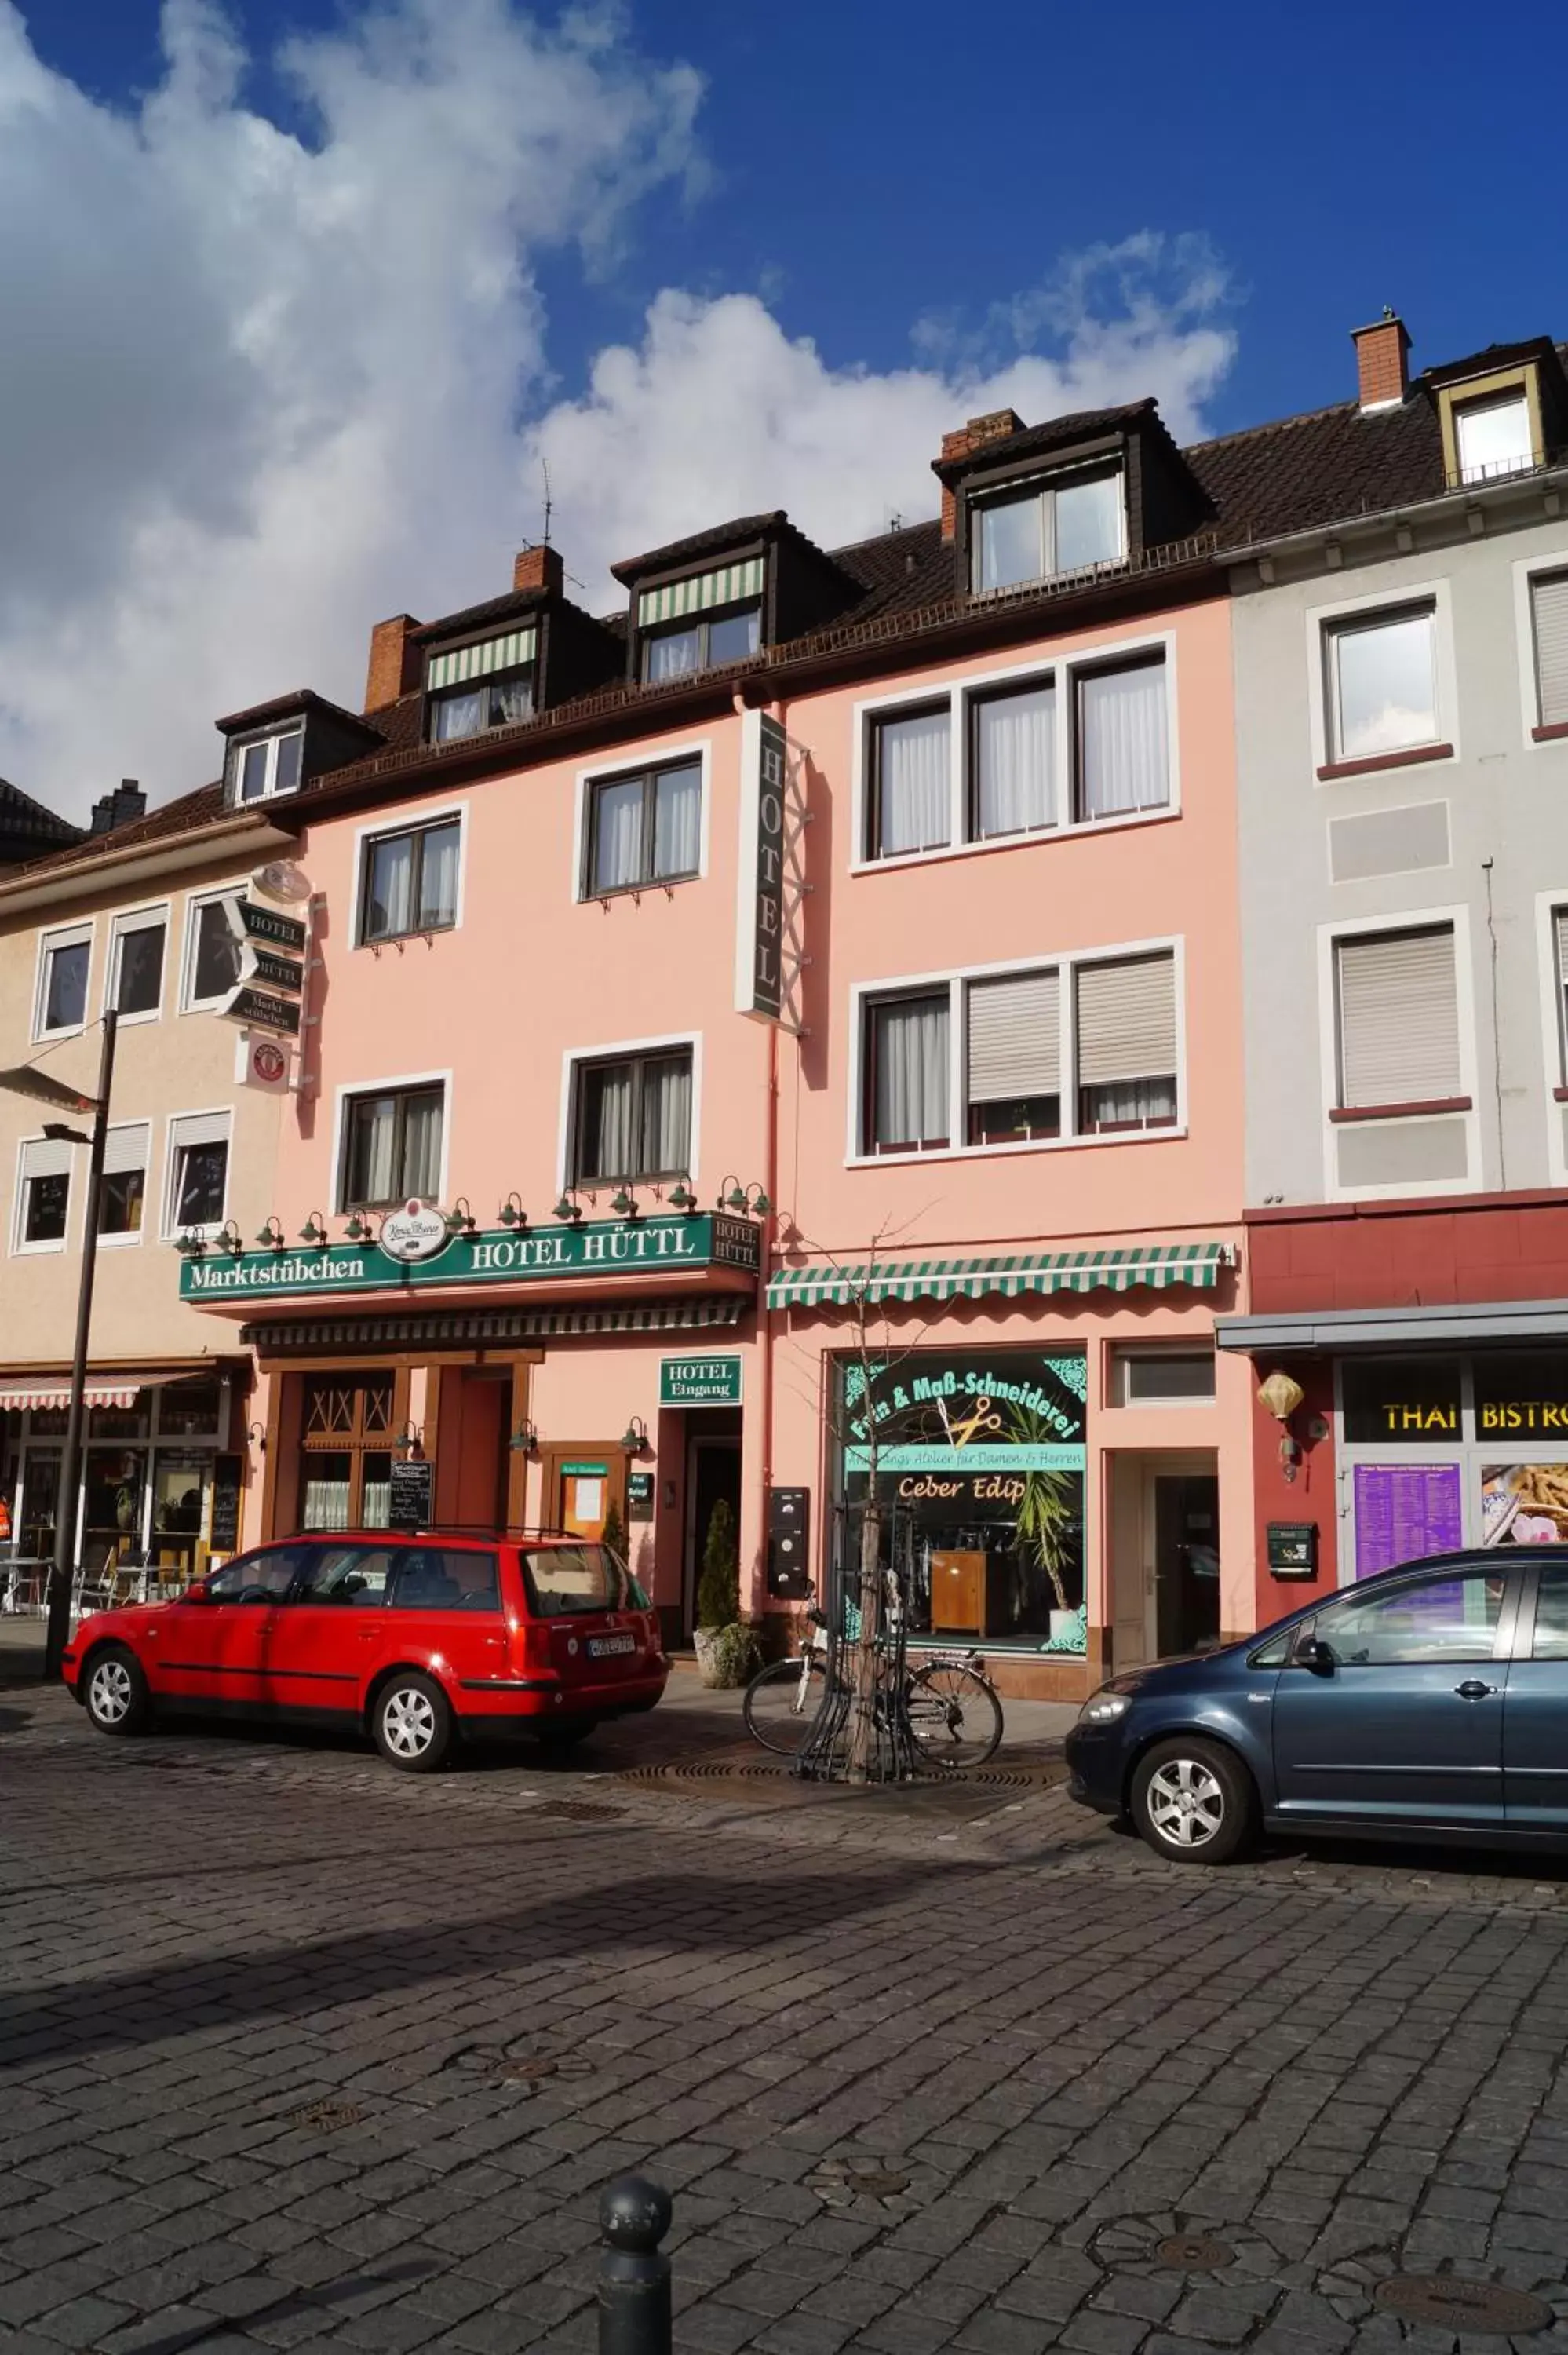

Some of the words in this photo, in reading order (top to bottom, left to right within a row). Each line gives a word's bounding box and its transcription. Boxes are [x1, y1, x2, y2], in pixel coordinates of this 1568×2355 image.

[757, 743, 782, 990] HOTEL
[251, 915, 299, 942] HOTEL
[471, 1238, 572, 1269] HOTEL
[582, 1225, 695, 1261] HÜTTL
[716, 1221, 757, 1245] HOTEL
[190, 1254, 364, 1290] Marktstübchen
[669, 1364, 732, 1381] HOTEL
[671, 1382, 731, 1398] Eingang
[893, 1386, 910, 1409] &
[913, 1371, 1081, 1440] Maß-Schneiderei
[1382, 1404, 1457, 1430] THAI
[899, 1474, 965, 1498] Ceber
[972, 1473, 1026, 1506] Edip
